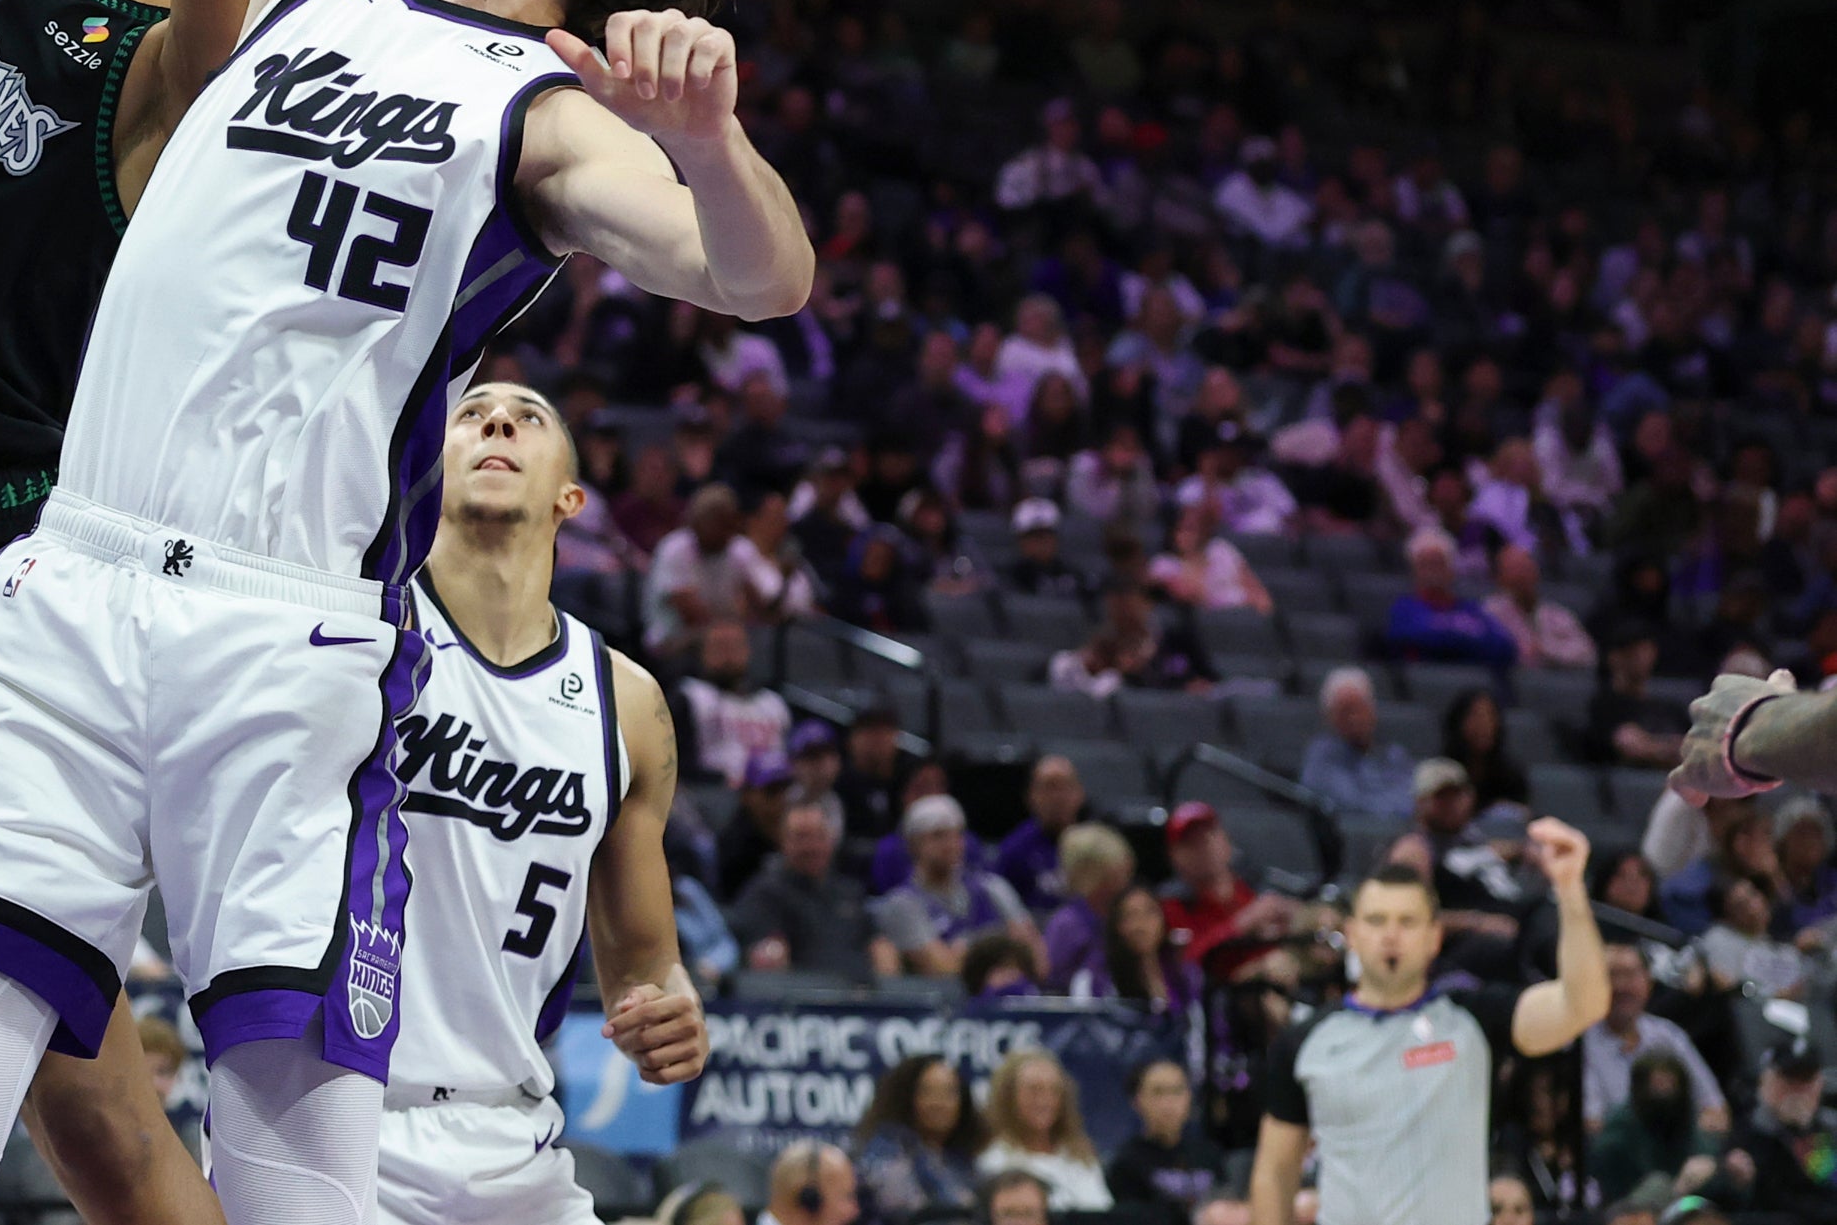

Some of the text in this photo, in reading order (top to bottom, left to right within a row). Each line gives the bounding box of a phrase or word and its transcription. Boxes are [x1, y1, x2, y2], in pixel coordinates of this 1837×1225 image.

[44, 20, 103, 70] sezzle
[227, 47, 461, 169] Kings
[286, 170, 434, 313] 42
[392, 713, 591, 842] Kings
[502, 861, 573, 960] 5
[350, 962, 394, 1000] KINGS
[704, 1013, 870, 1070] PACIFIC
